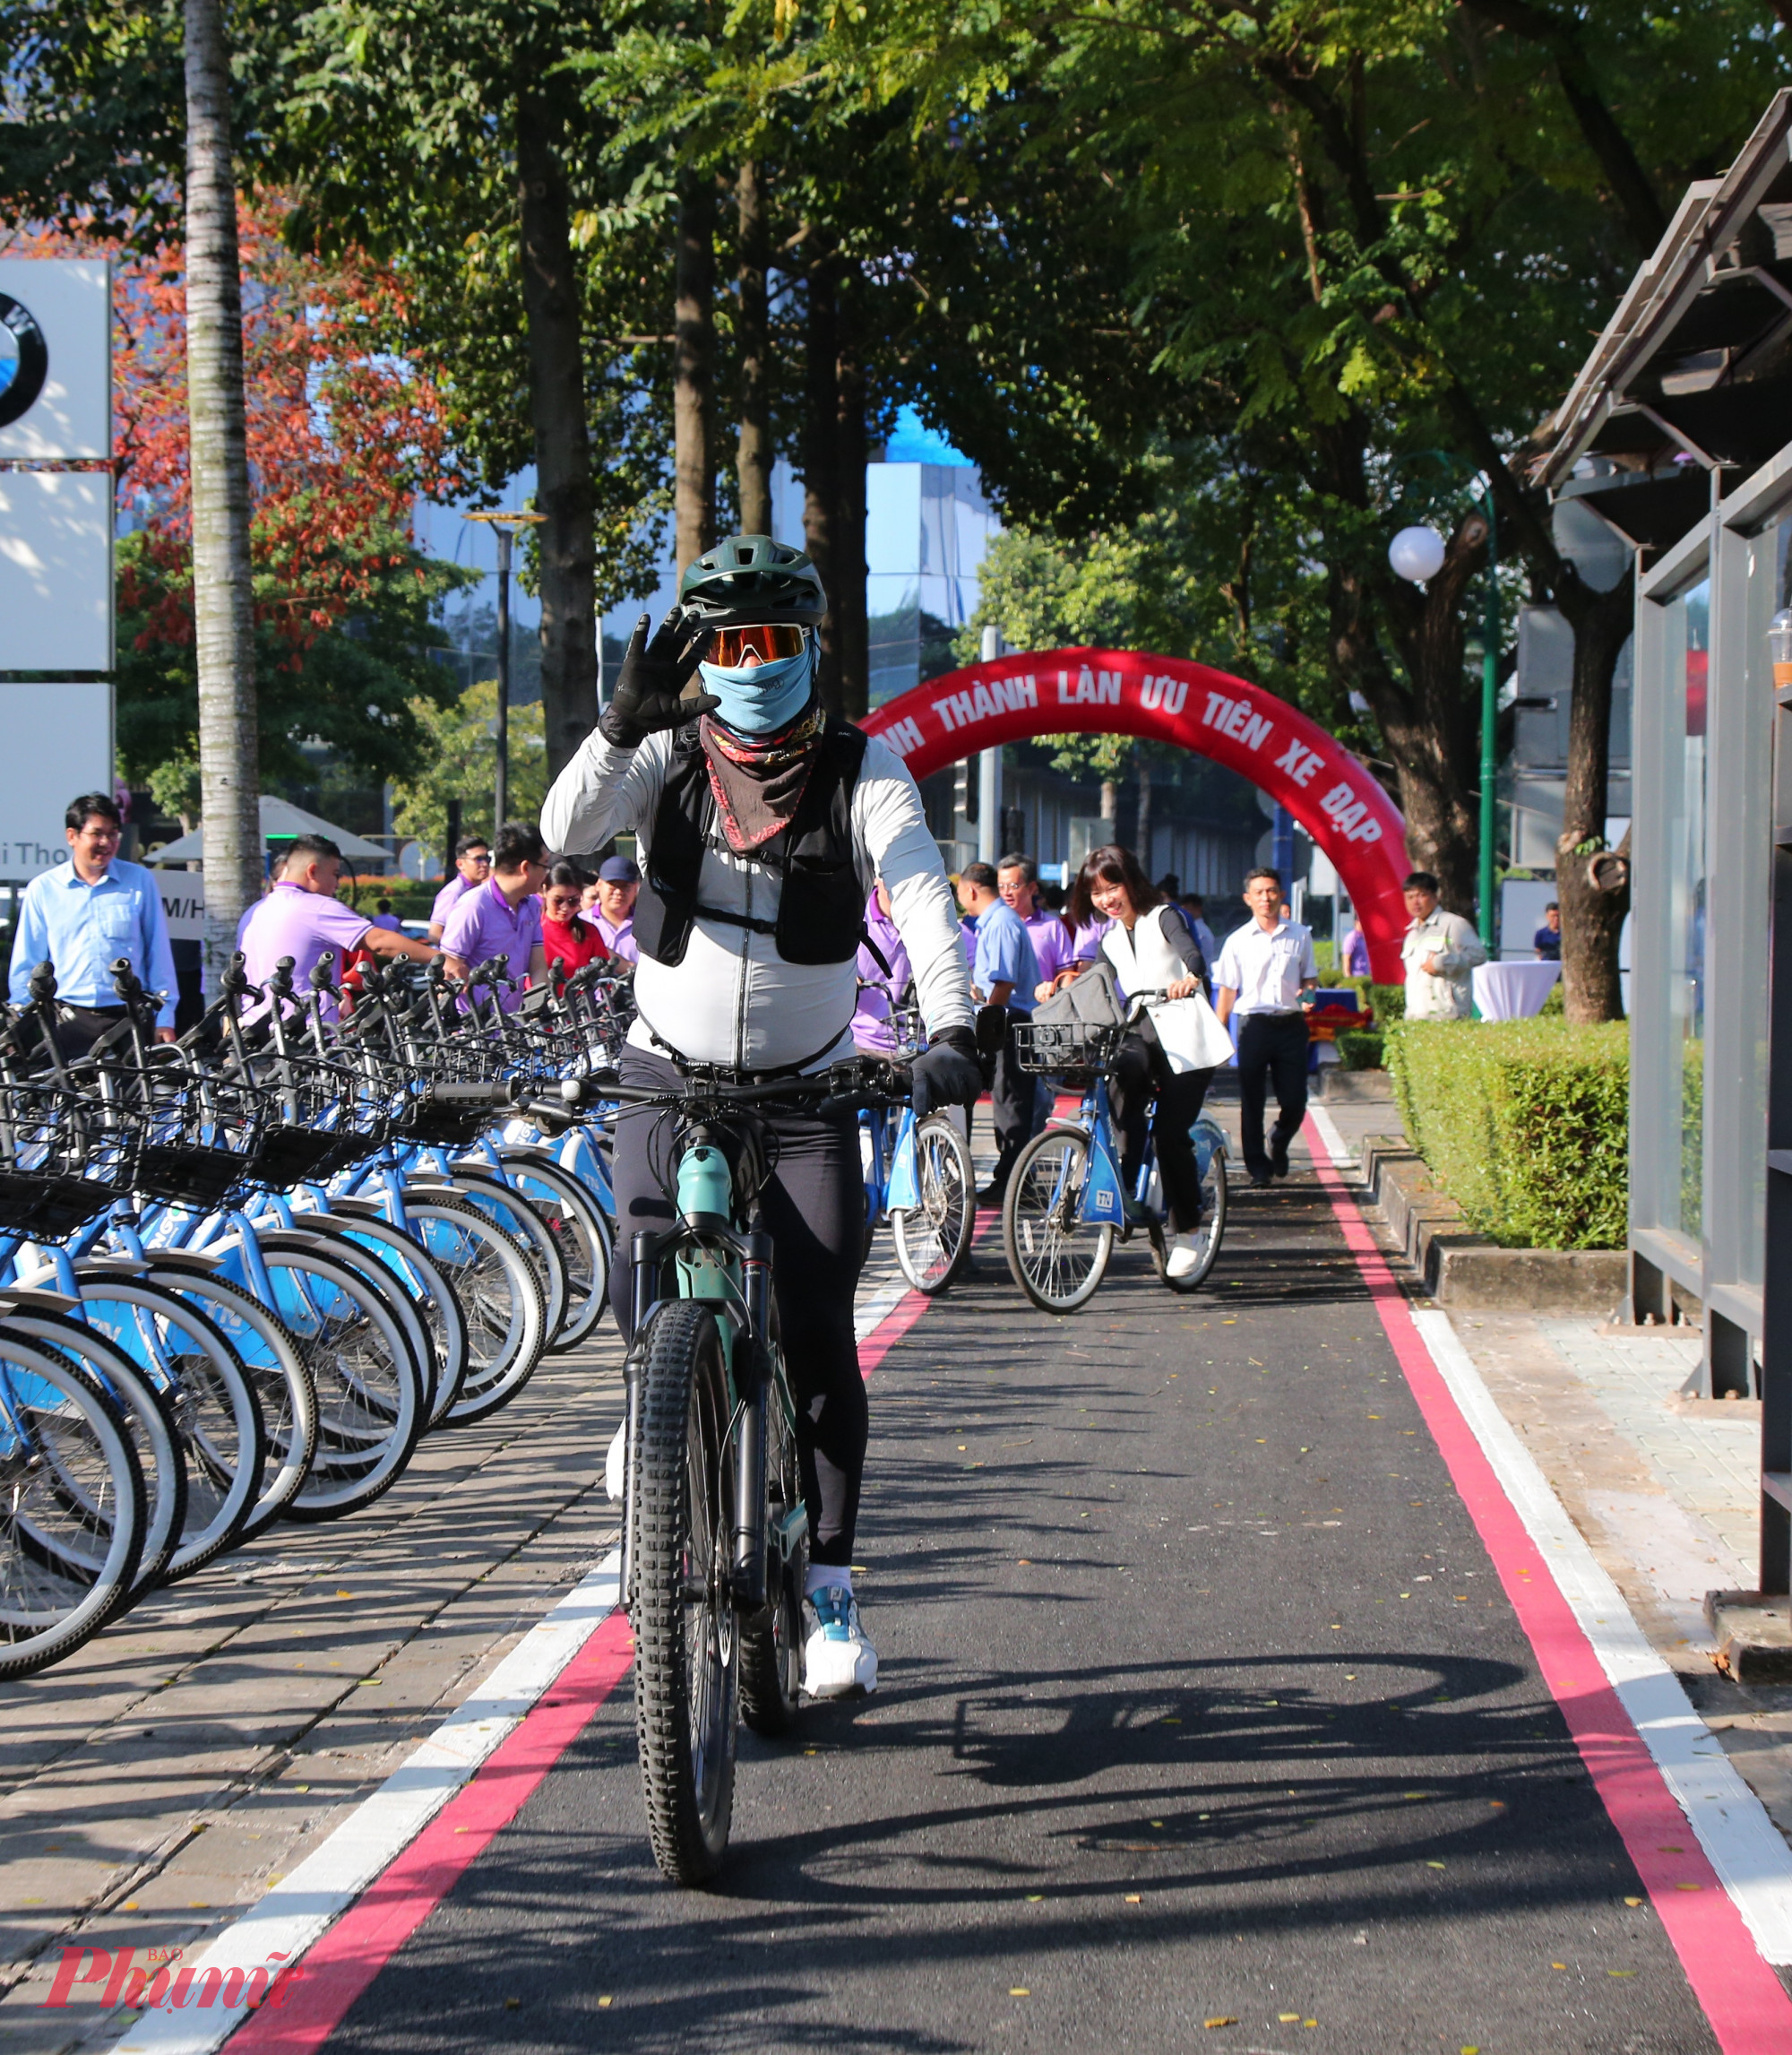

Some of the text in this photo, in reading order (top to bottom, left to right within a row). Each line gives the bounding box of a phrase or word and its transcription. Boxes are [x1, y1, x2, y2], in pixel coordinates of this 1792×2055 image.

[931, 674, 1038, 732] THÀNH
[1058, 664, 1123, 705] LÀN
[1140, 674, 1189, 715] ƯU
[1202, 690, 1274, 752] TIÊN
[1273, 738, 1326, 788] XE
[1319, 781, 1383, 842] ĐẠP
